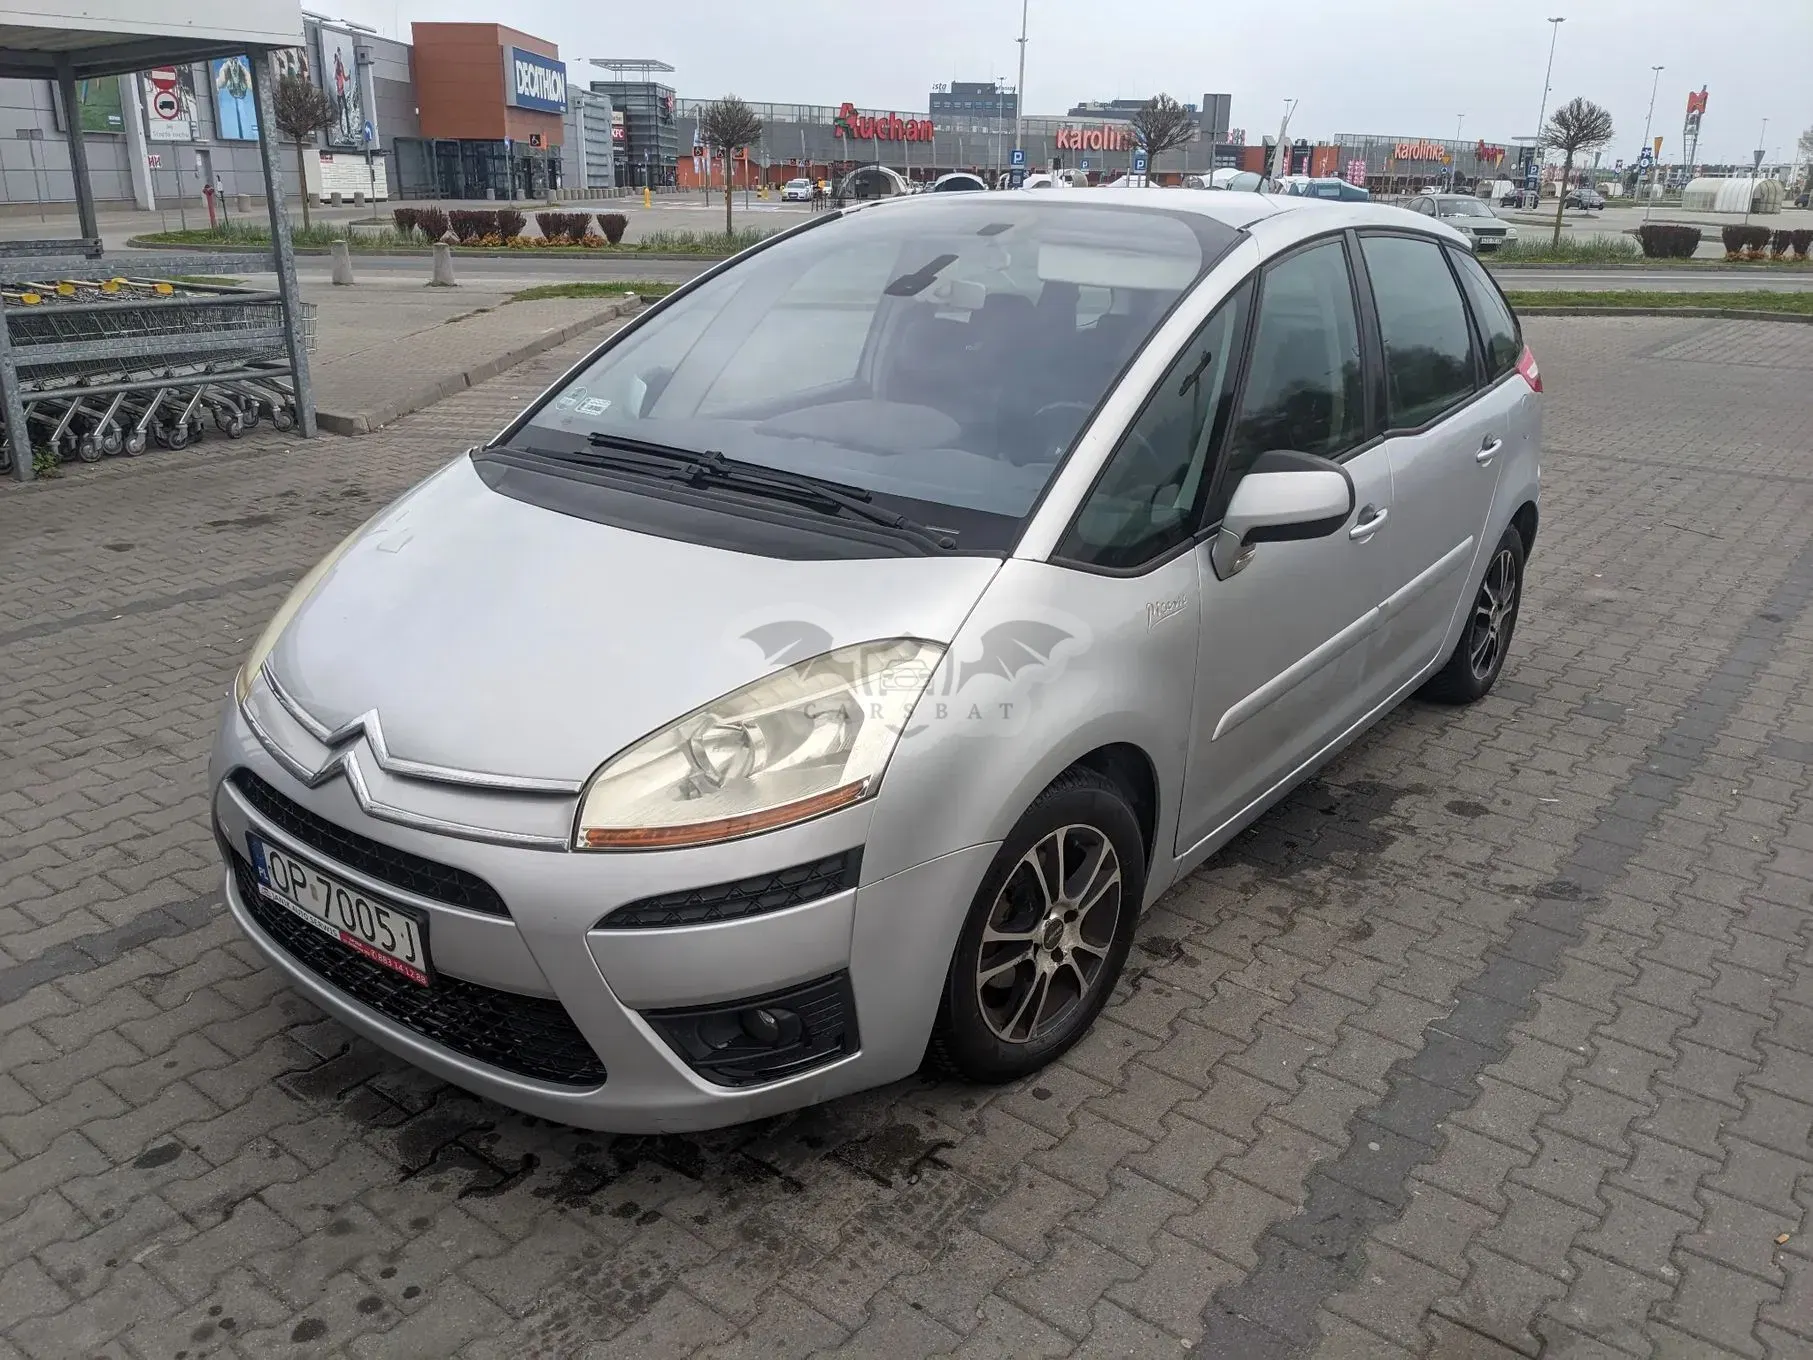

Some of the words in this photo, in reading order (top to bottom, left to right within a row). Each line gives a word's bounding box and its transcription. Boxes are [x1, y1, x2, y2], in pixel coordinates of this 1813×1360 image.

[515, 60, 566, 104] DECATHLON
[612, 128, 625, 138] KFC
[834, 103, 934, 142] Auchan
[1056, 125, 1137, 152] karolin
[269, 850, 307, 902] OP
[316, 875, 416, 963] 7005J
